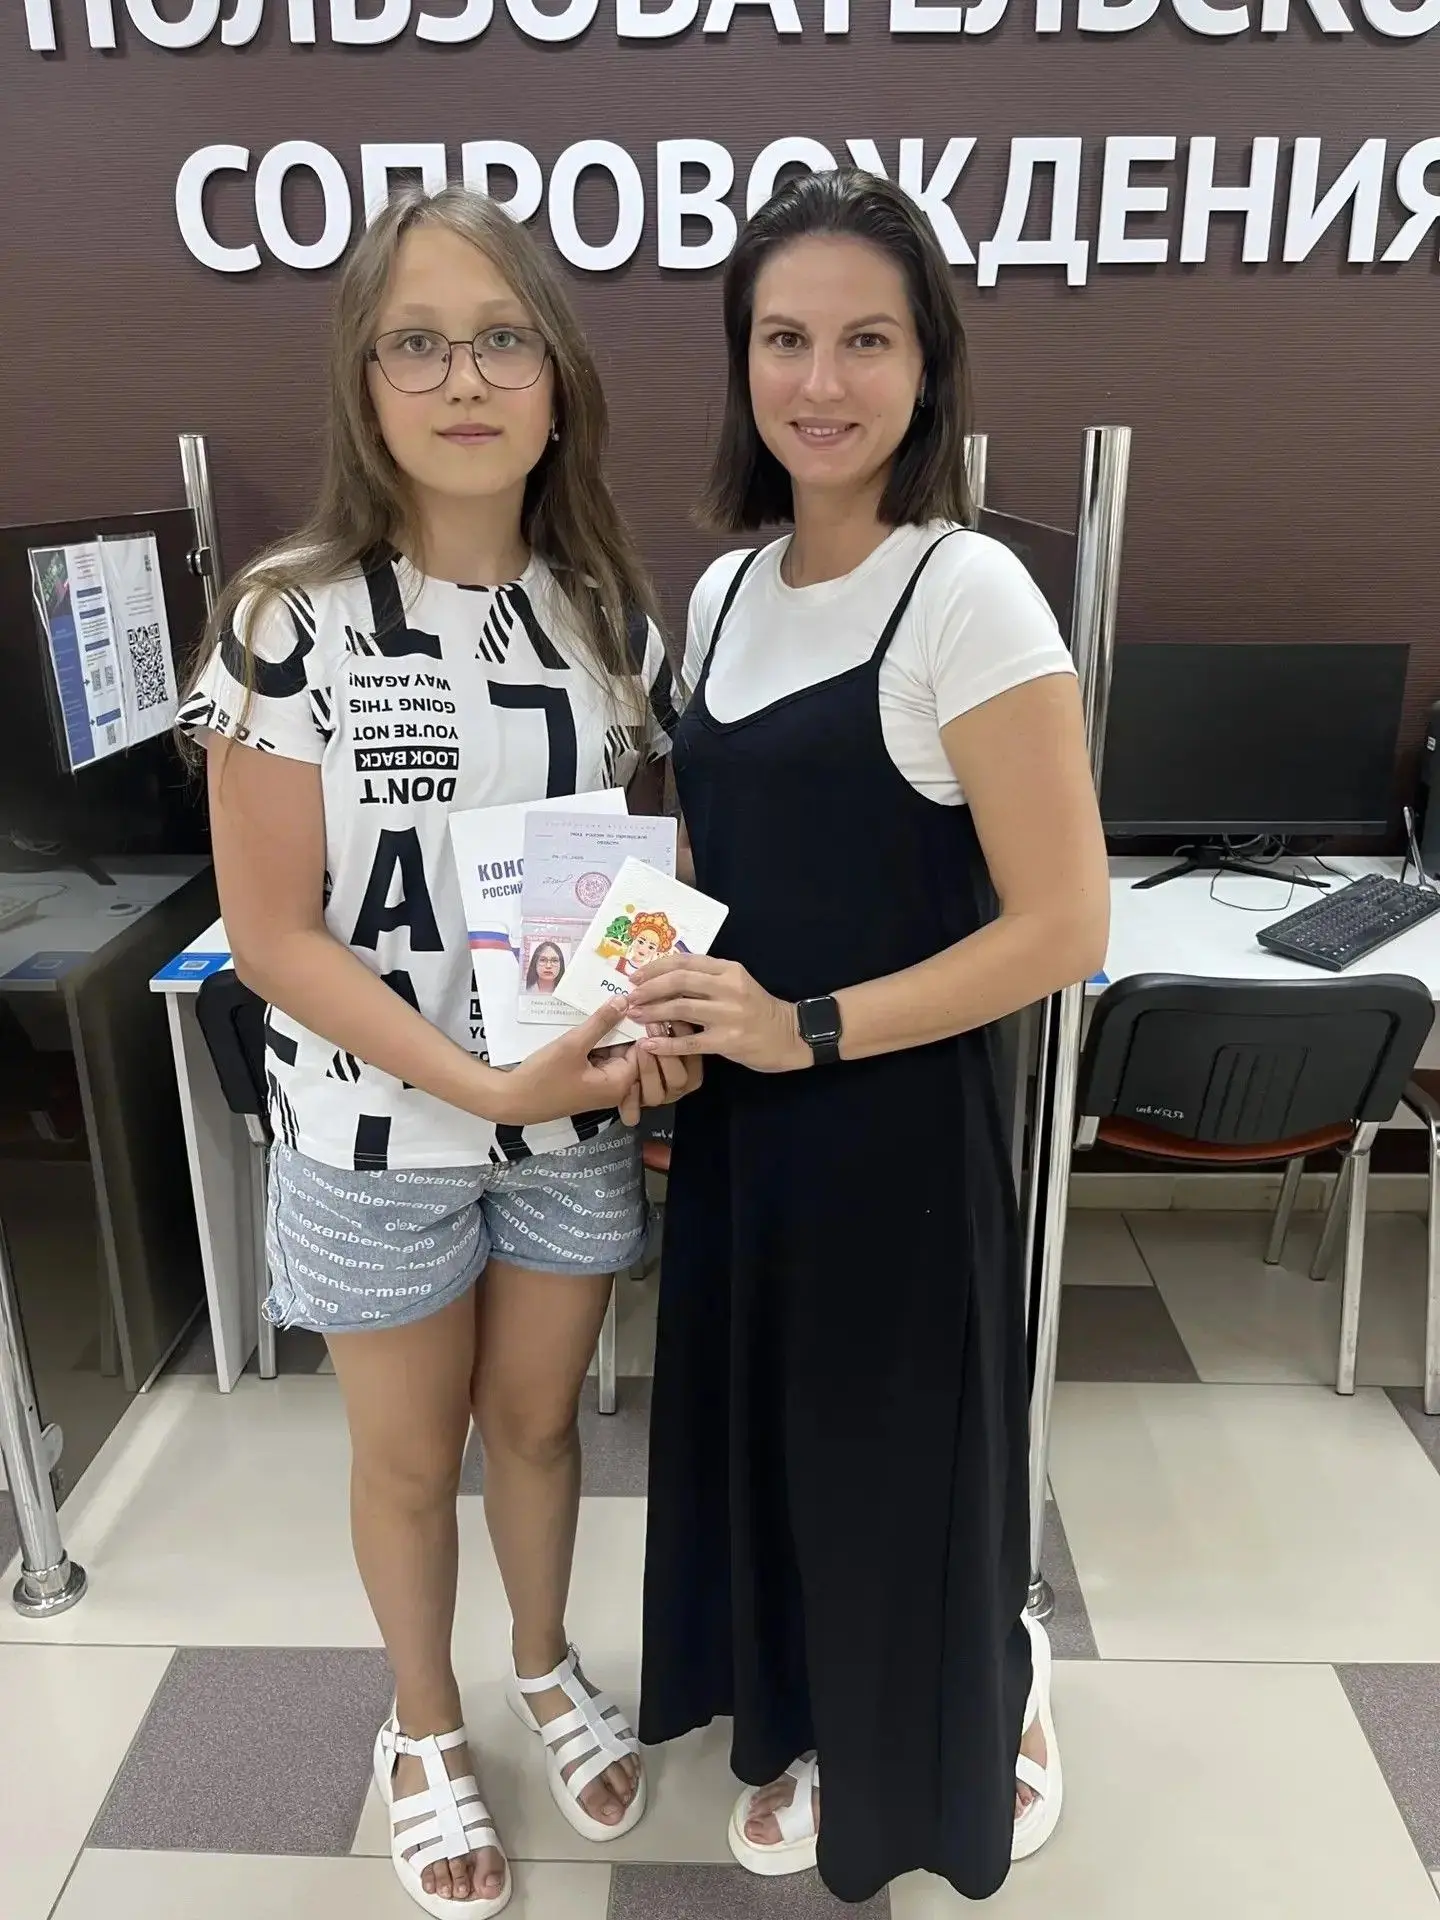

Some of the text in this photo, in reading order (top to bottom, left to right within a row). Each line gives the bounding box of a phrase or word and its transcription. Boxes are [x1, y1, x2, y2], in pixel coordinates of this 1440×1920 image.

[349, 672, 451, 691] WAY AGAIN!
[349, 698, 456, 714] GOING THIS
[352, 723, 459, 741] YOU'RE NOT
[360, 750, 458, 768] LOOK BACK
[359, 776, 457, 805] DON'T
